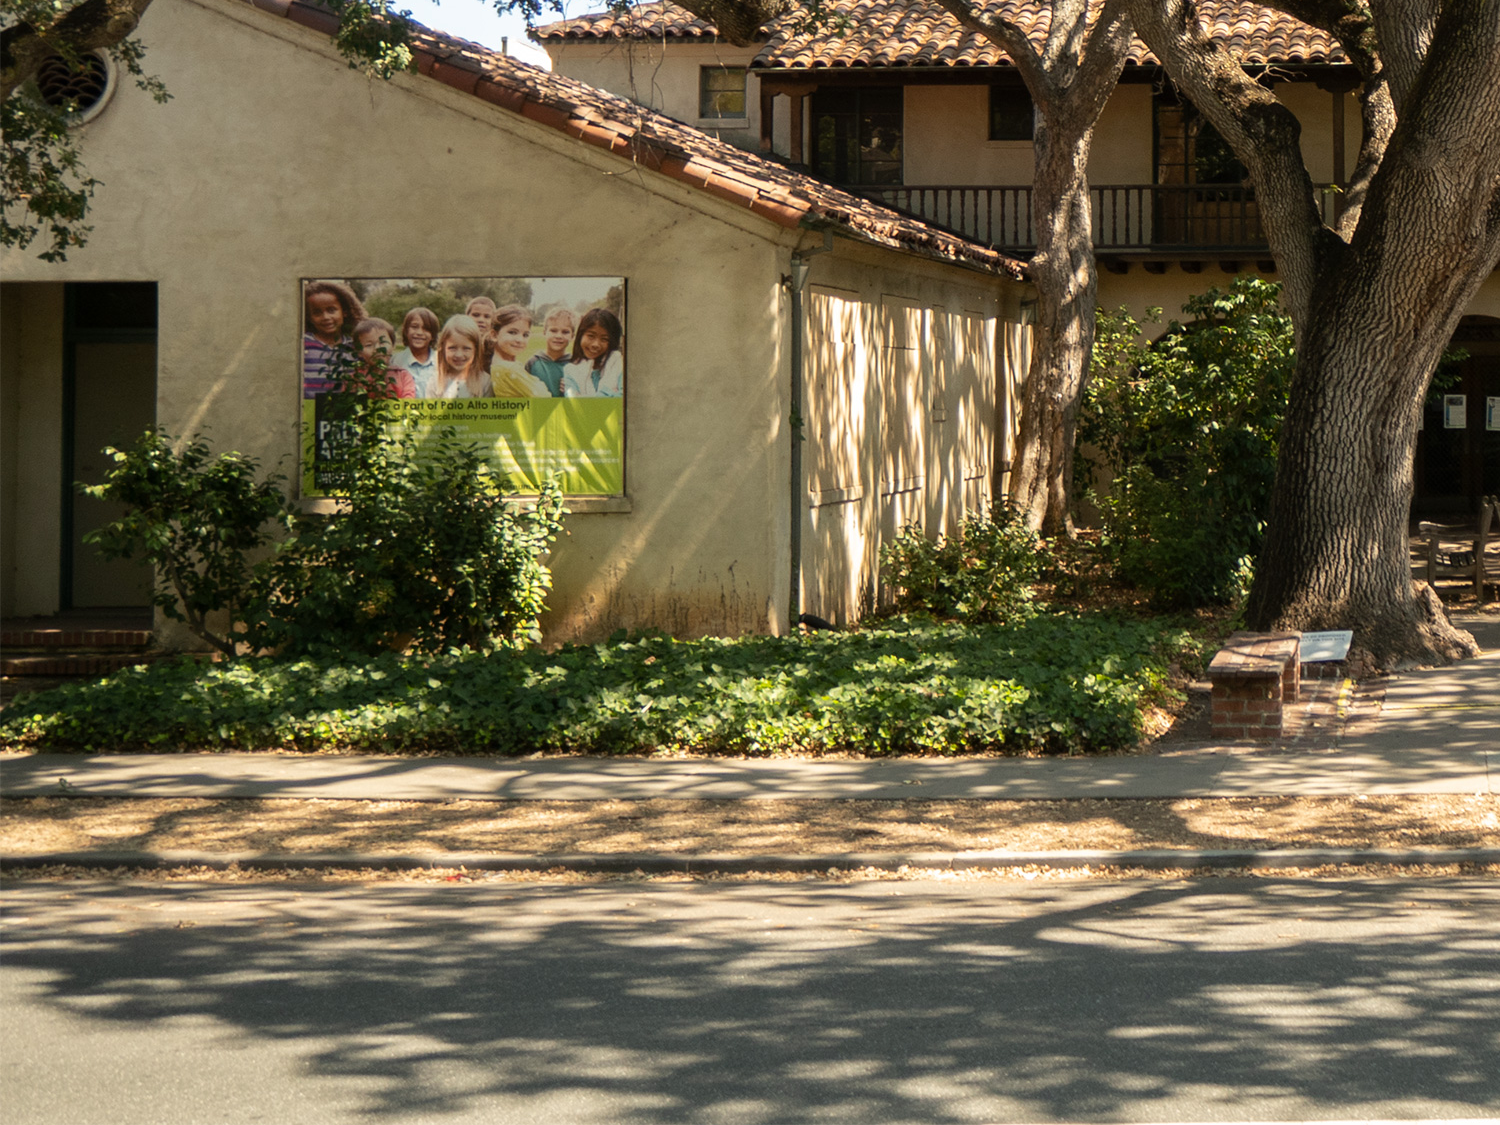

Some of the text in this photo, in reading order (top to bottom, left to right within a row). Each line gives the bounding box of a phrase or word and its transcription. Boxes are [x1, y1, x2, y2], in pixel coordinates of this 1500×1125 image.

[393, 403, 401, 411] a
[404, 401, 424, 411] Part
[427, 401, 438, 411] of
[440, 401, 464, 410] Palo
[467, 401, 489, 410] Alto
[492, 401, 530, 411] History!
[429, 413, 450, 421] local
[452, 413, 478, 422] history
[480, 413, 518, 421] museum!
